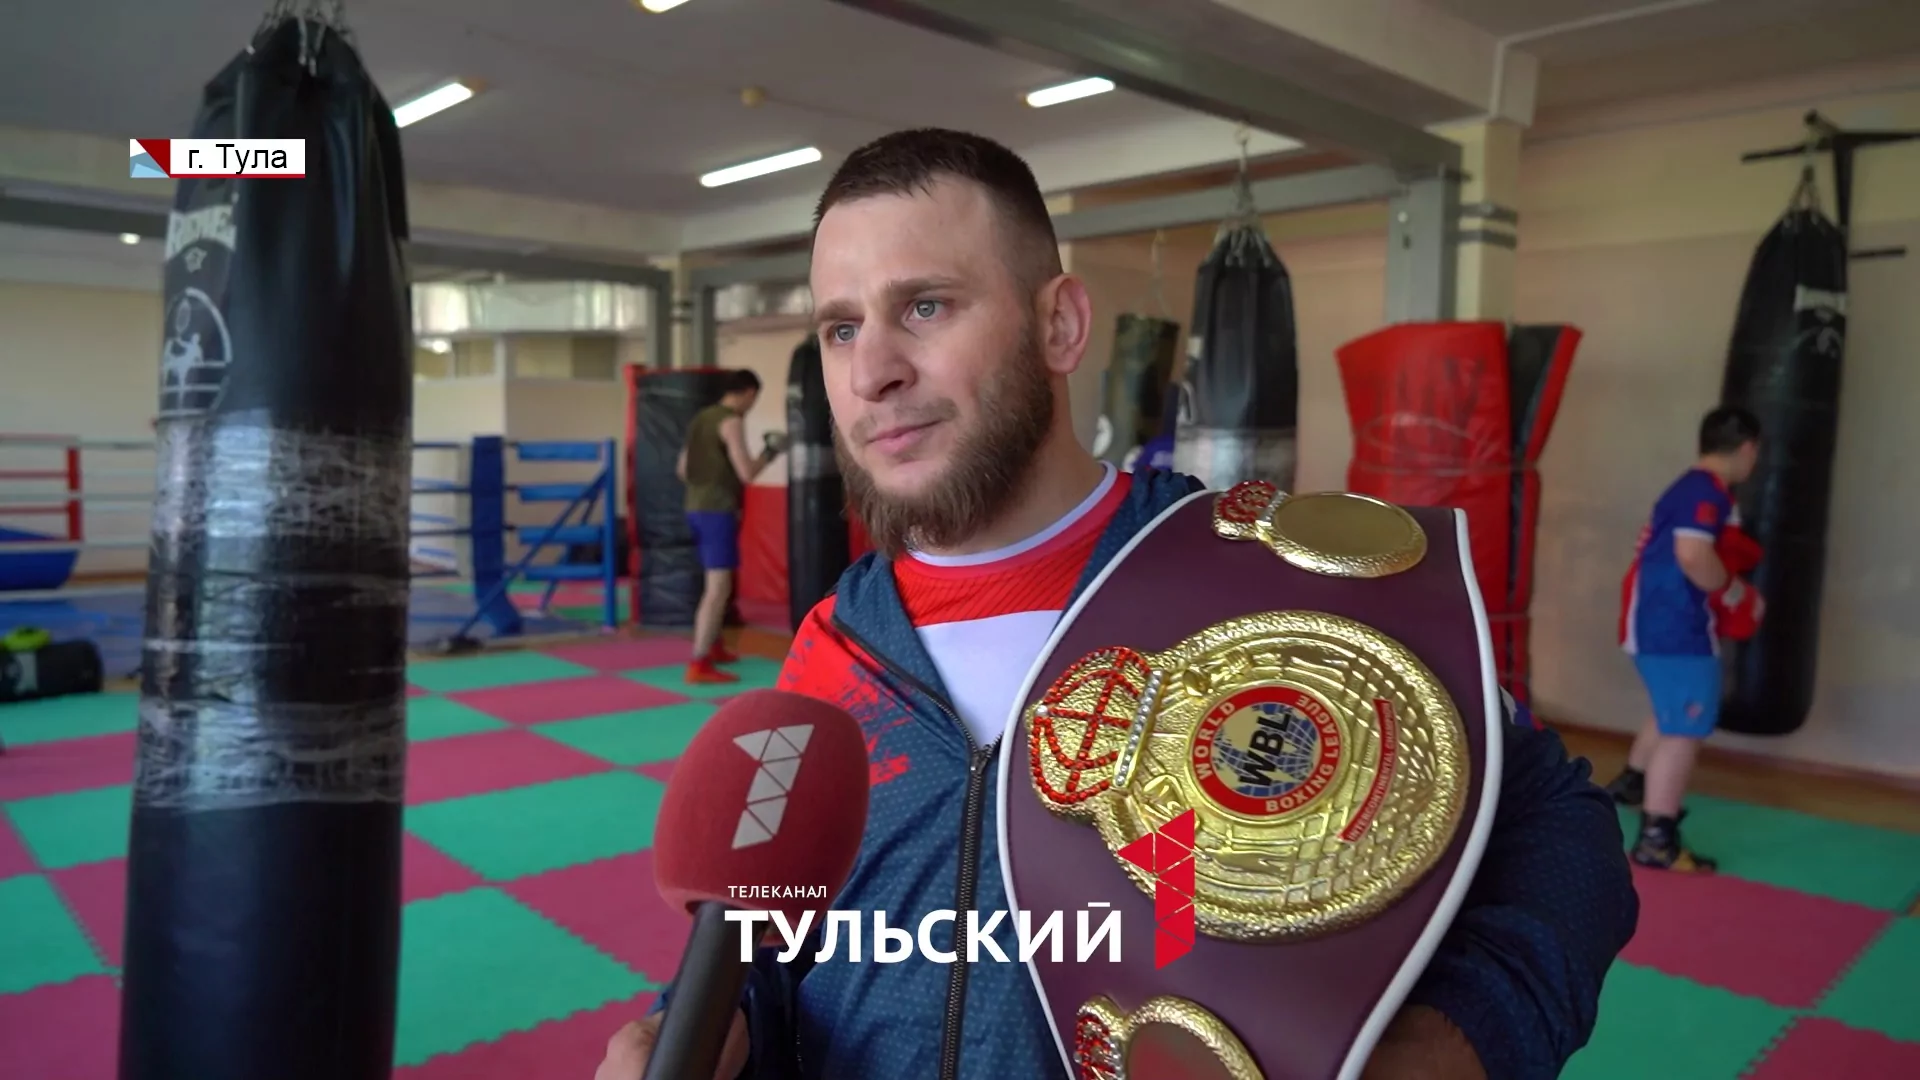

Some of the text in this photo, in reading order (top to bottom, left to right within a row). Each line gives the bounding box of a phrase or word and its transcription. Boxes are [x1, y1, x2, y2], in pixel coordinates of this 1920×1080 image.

[1195, 695, 1340, 813] WORLD BOXING LEAGUE
[1239, 714, 1292, 786] WBL
[1347, 752, 1395, 842] INTERCONTINENTAL
